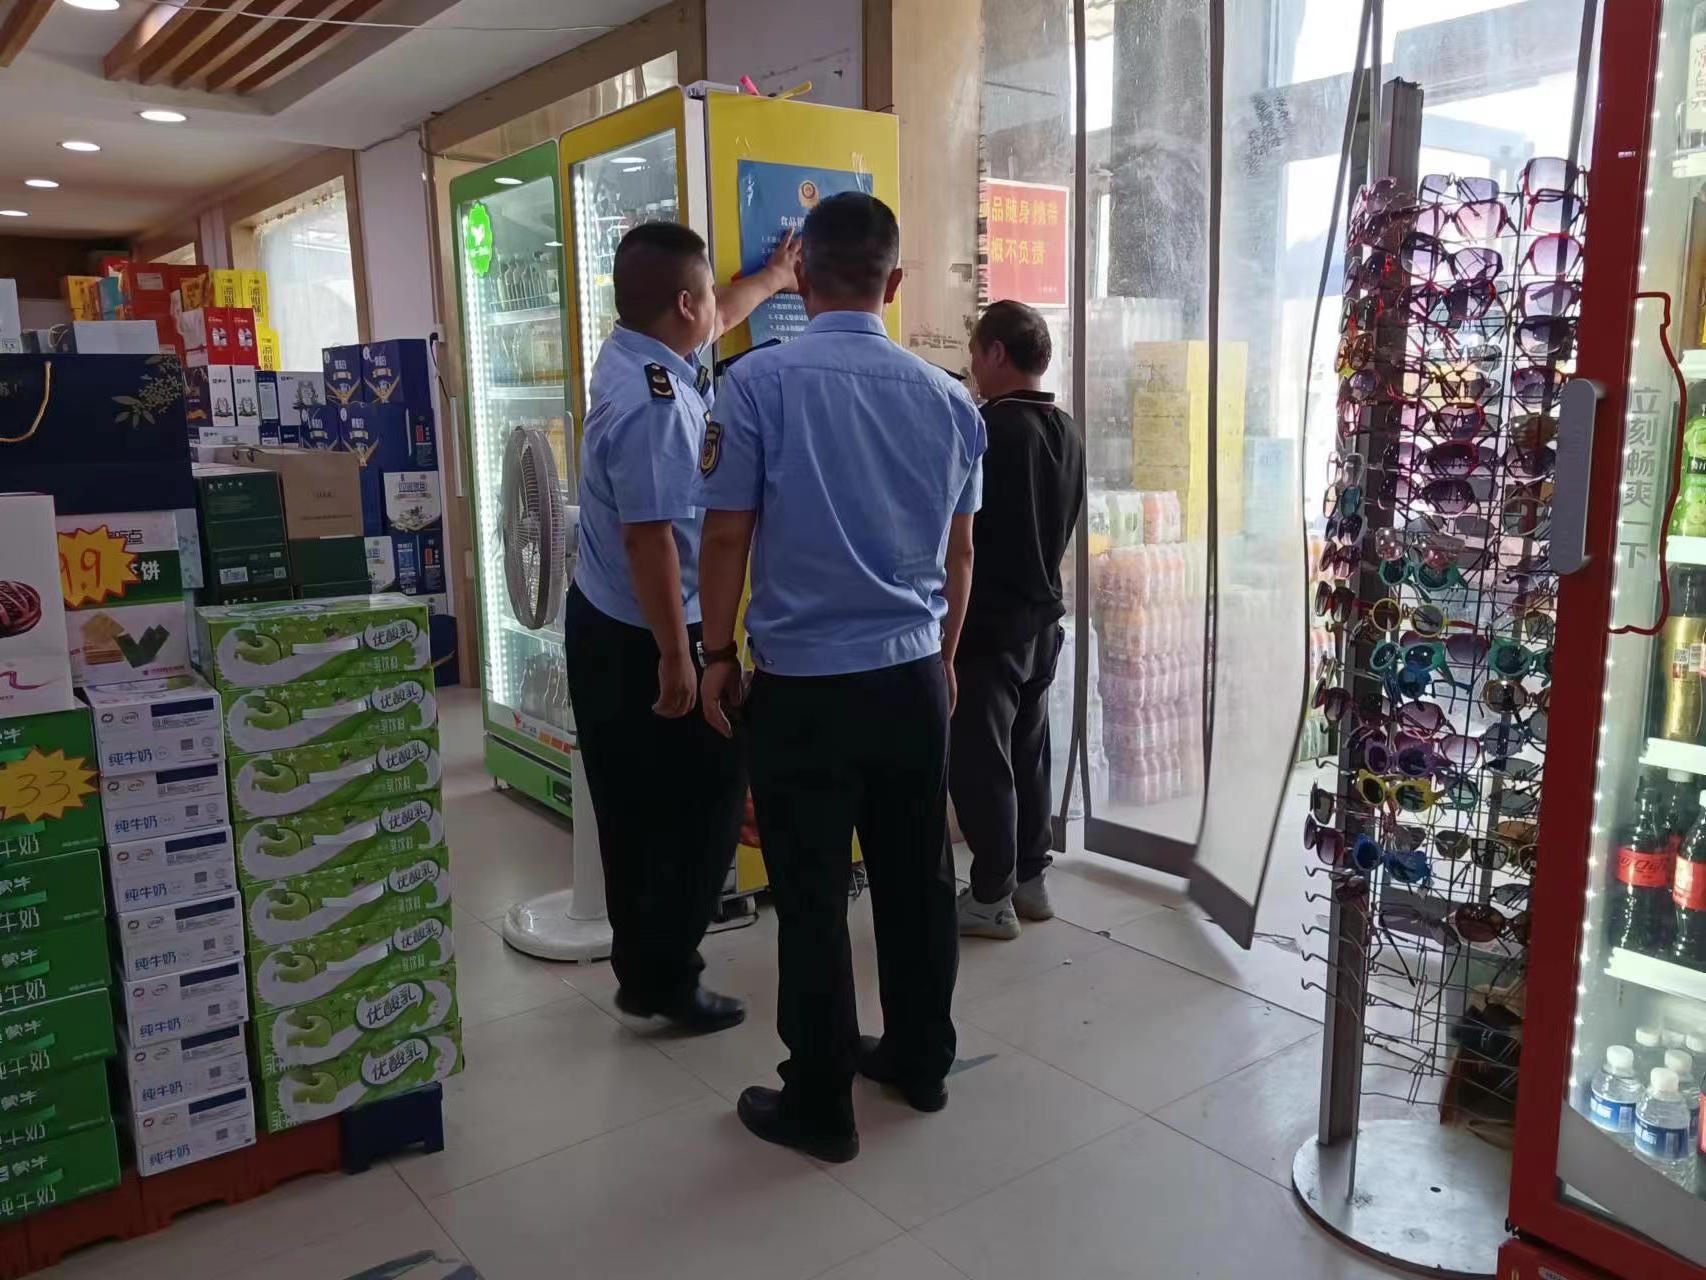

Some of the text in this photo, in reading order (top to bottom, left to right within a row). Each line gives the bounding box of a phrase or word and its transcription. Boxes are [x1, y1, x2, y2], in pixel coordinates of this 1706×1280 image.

[1620, 387, 1662, 568] 立刻畅爽一下
[373, 621, 412, 647] 优酸乳
[381, 684, 419, 709] 优酸乳
[0, 728, 21, 744] 牛
[109, 749, 152, 767] 纯牛奶
[16, 770, 70, 808] 33
[115, 815, 158, 833] 纯牛奶
[125, 883, 167, 903] 纯牛奶
[135, 952, 177, 971] 纯牛奶
[366, 986, 417, 1025] 优酸乳
[140, 1017, 181, 1036] 纯牛奶
[371, 1041, 422, 1081] 优酸乳
